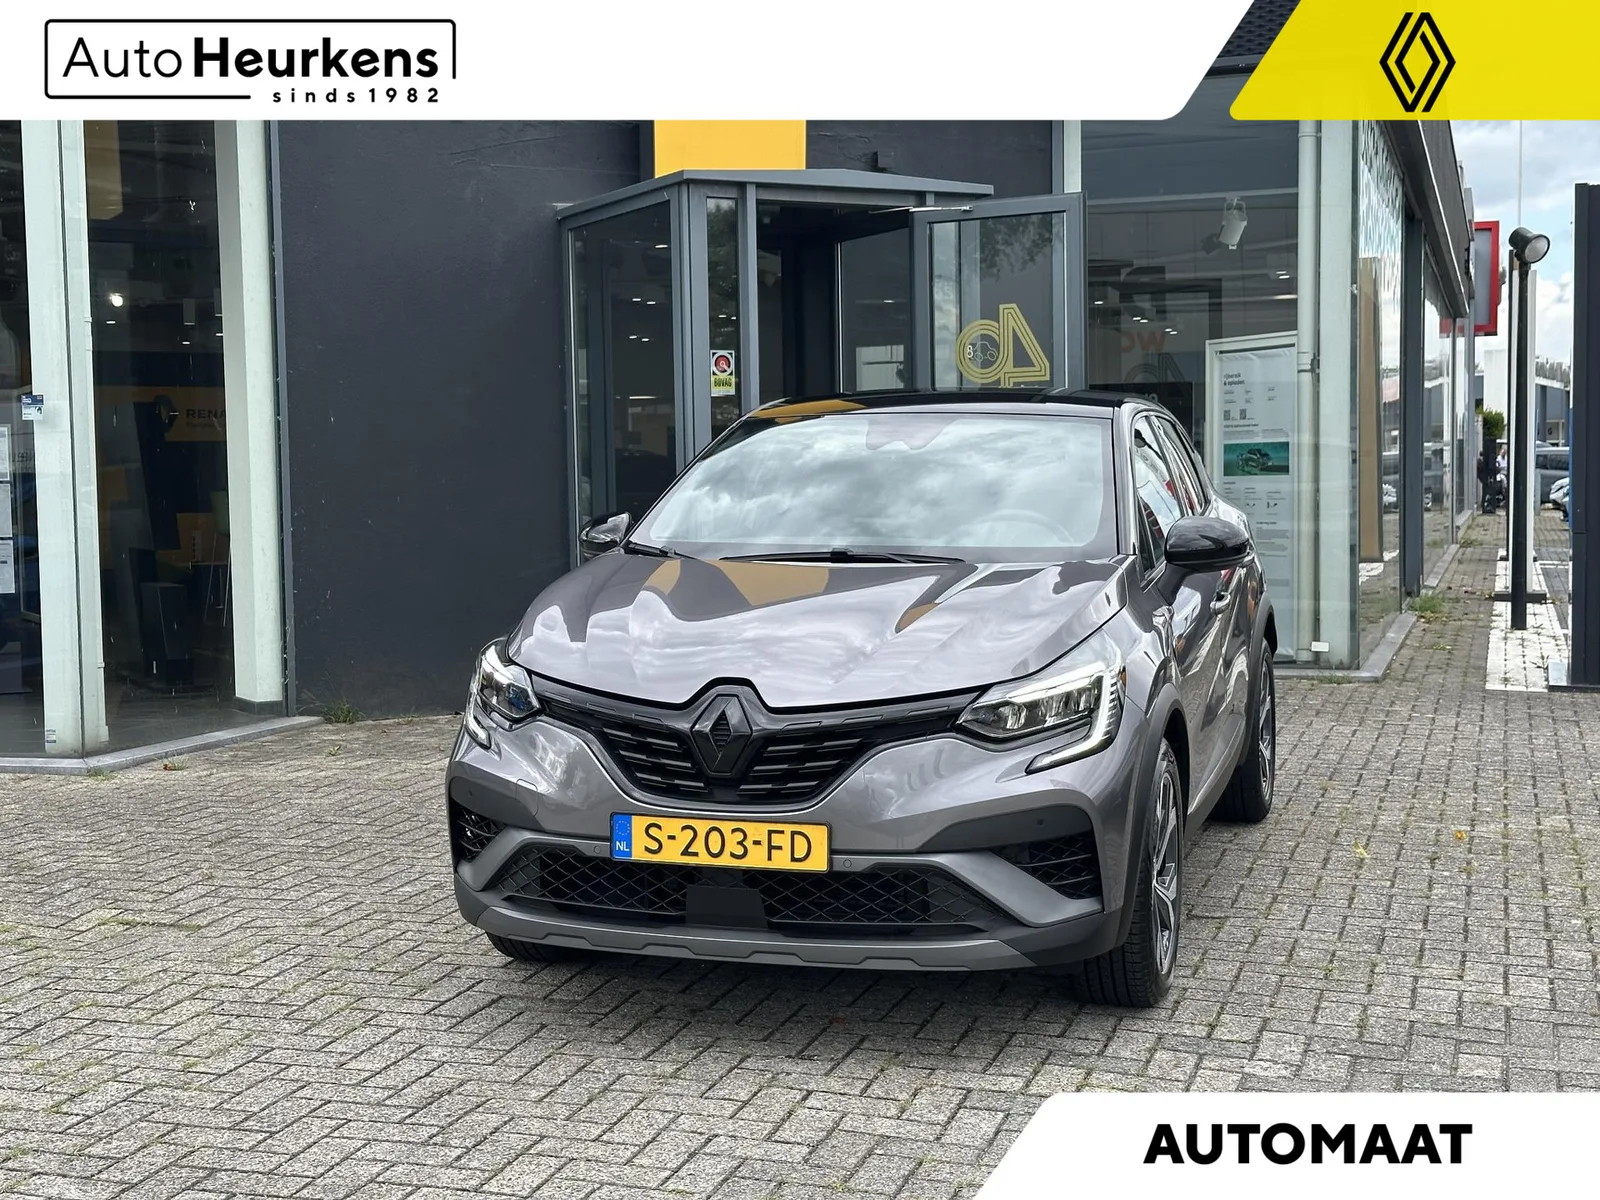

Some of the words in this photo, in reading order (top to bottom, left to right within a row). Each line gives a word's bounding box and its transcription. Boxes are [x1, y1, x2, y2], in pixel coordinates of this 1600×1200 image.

[713, 377, 732, 388] BOVAG
[615, 840, 630, 852] NL
[643, 822, 812, 863] S-203-FD
